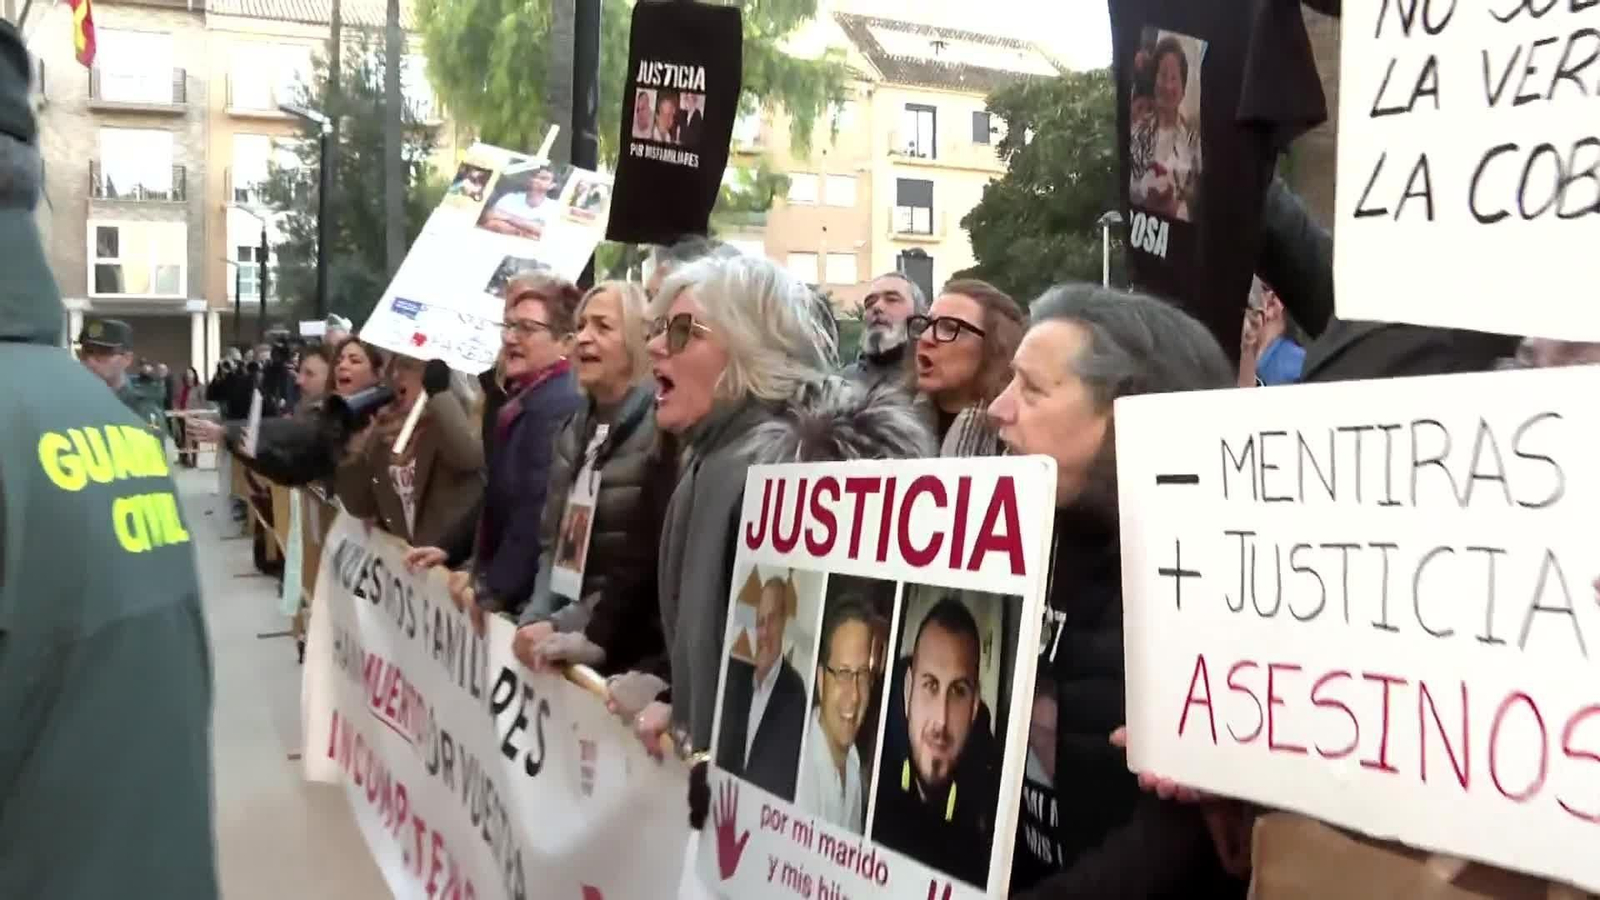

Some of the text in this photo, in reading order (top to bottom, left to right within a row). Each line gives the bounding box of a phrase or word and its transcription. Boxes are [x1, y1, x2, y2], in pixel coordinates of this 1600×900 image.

[636, 60, 706, 91] JUSTICIA
[1370, 28, 1600, 118] LA VER
[1353, 151, 1434, 221] LA
[1129, 209, 1170, 260] OSA
[1220, 412, 1566, 509] MENTIRAS
[745, 475, 1027, 576] JUSTICIA
[1223, 529, 1589, 659] JUSTICIA
[760, 803, 889, 886] por mi marido
[767, 853, 778, 883] y
[781, 860, 812, 899] mis
